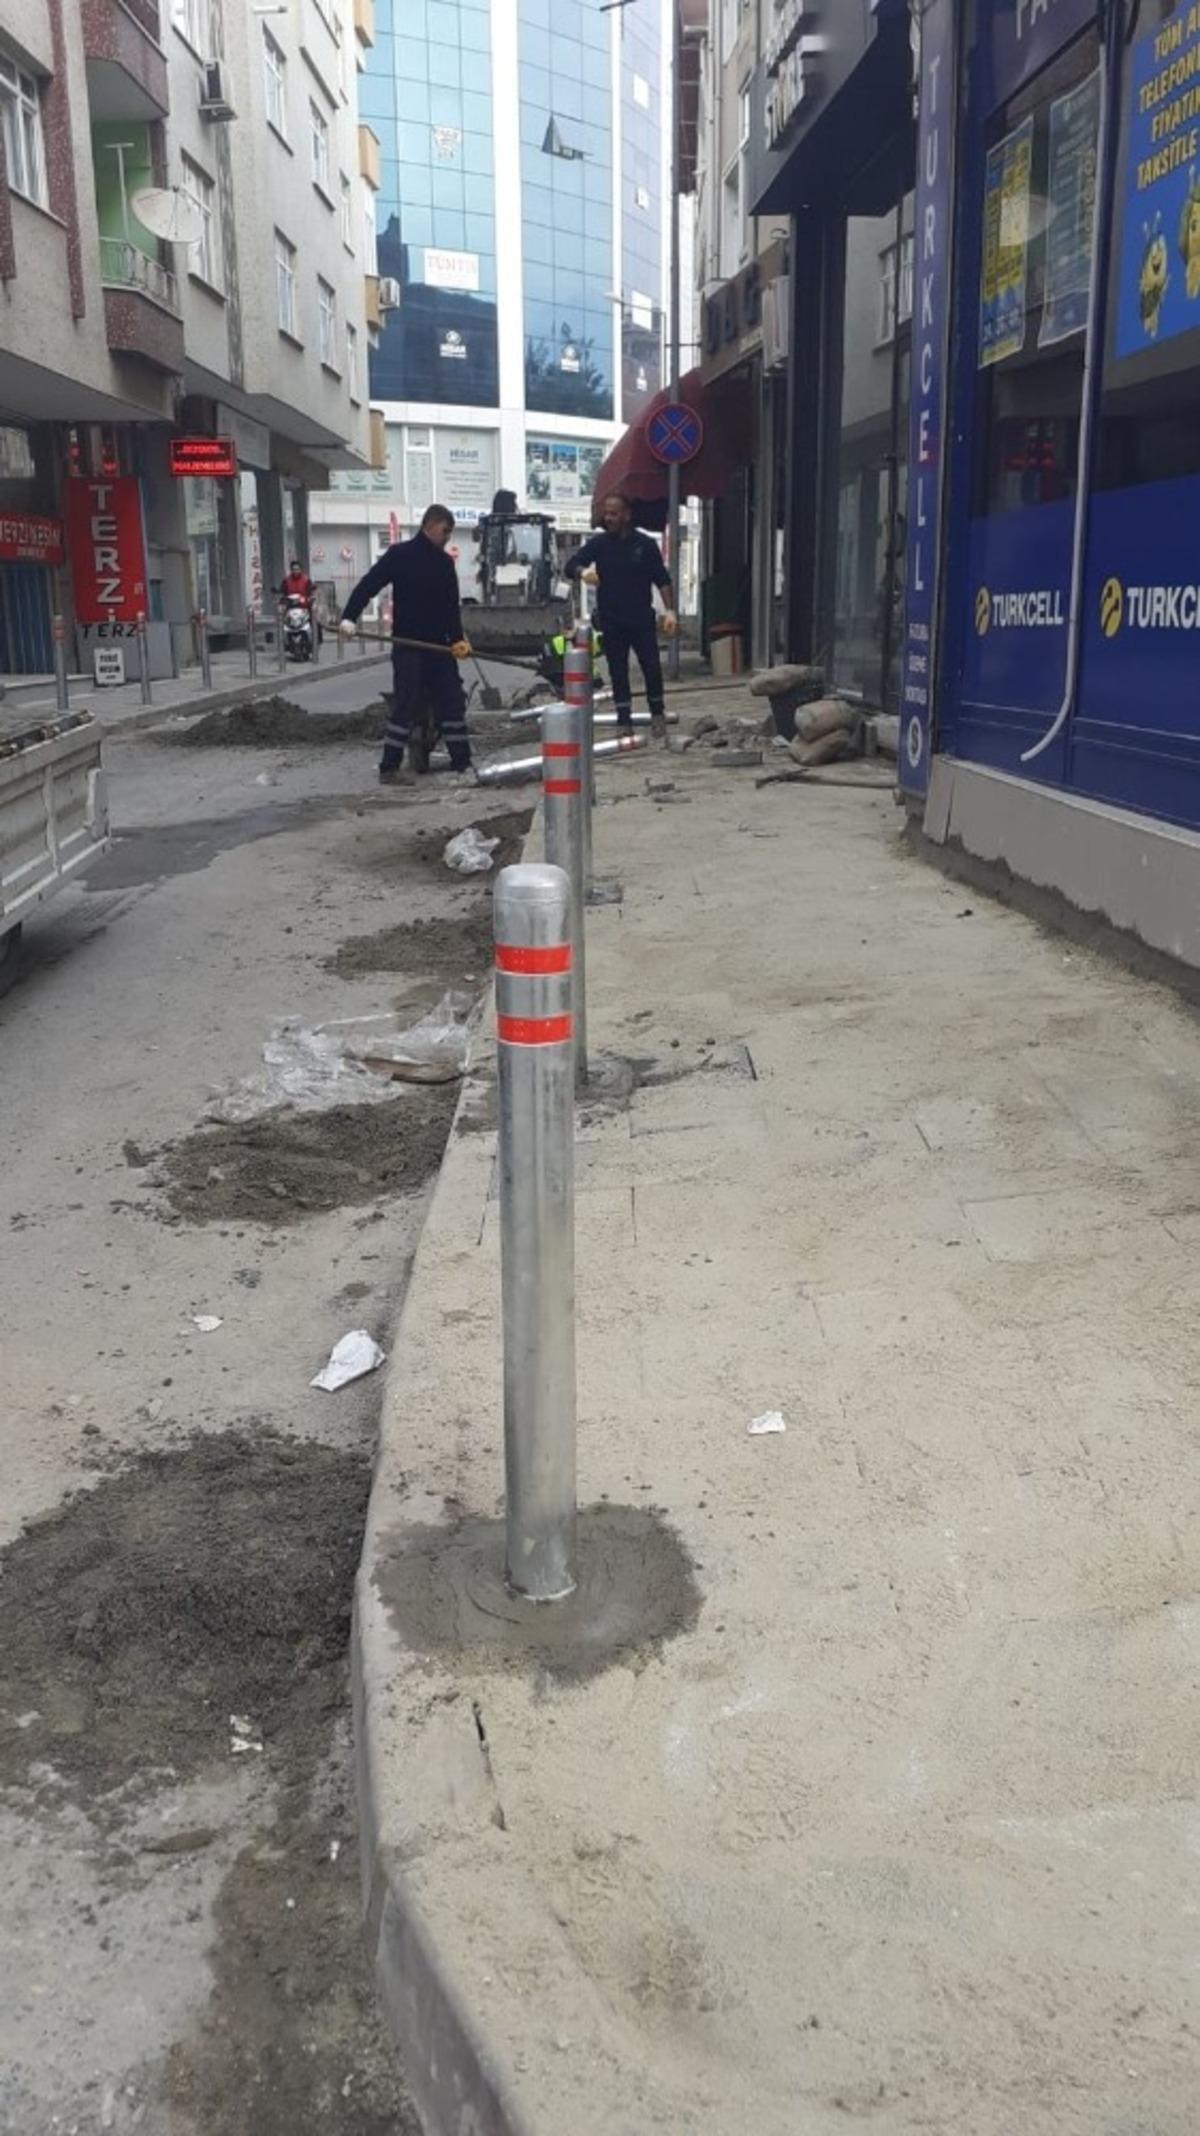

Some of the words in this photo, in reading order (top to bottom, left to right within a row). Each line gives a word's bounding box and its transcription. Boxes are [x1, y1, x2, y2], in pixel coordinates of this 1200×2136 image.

[1154, 18, 1183, 63] TÜM
[914, 54, 941, 592] TURKCELL
[993, 589, 1064, 627] TURKCELL
